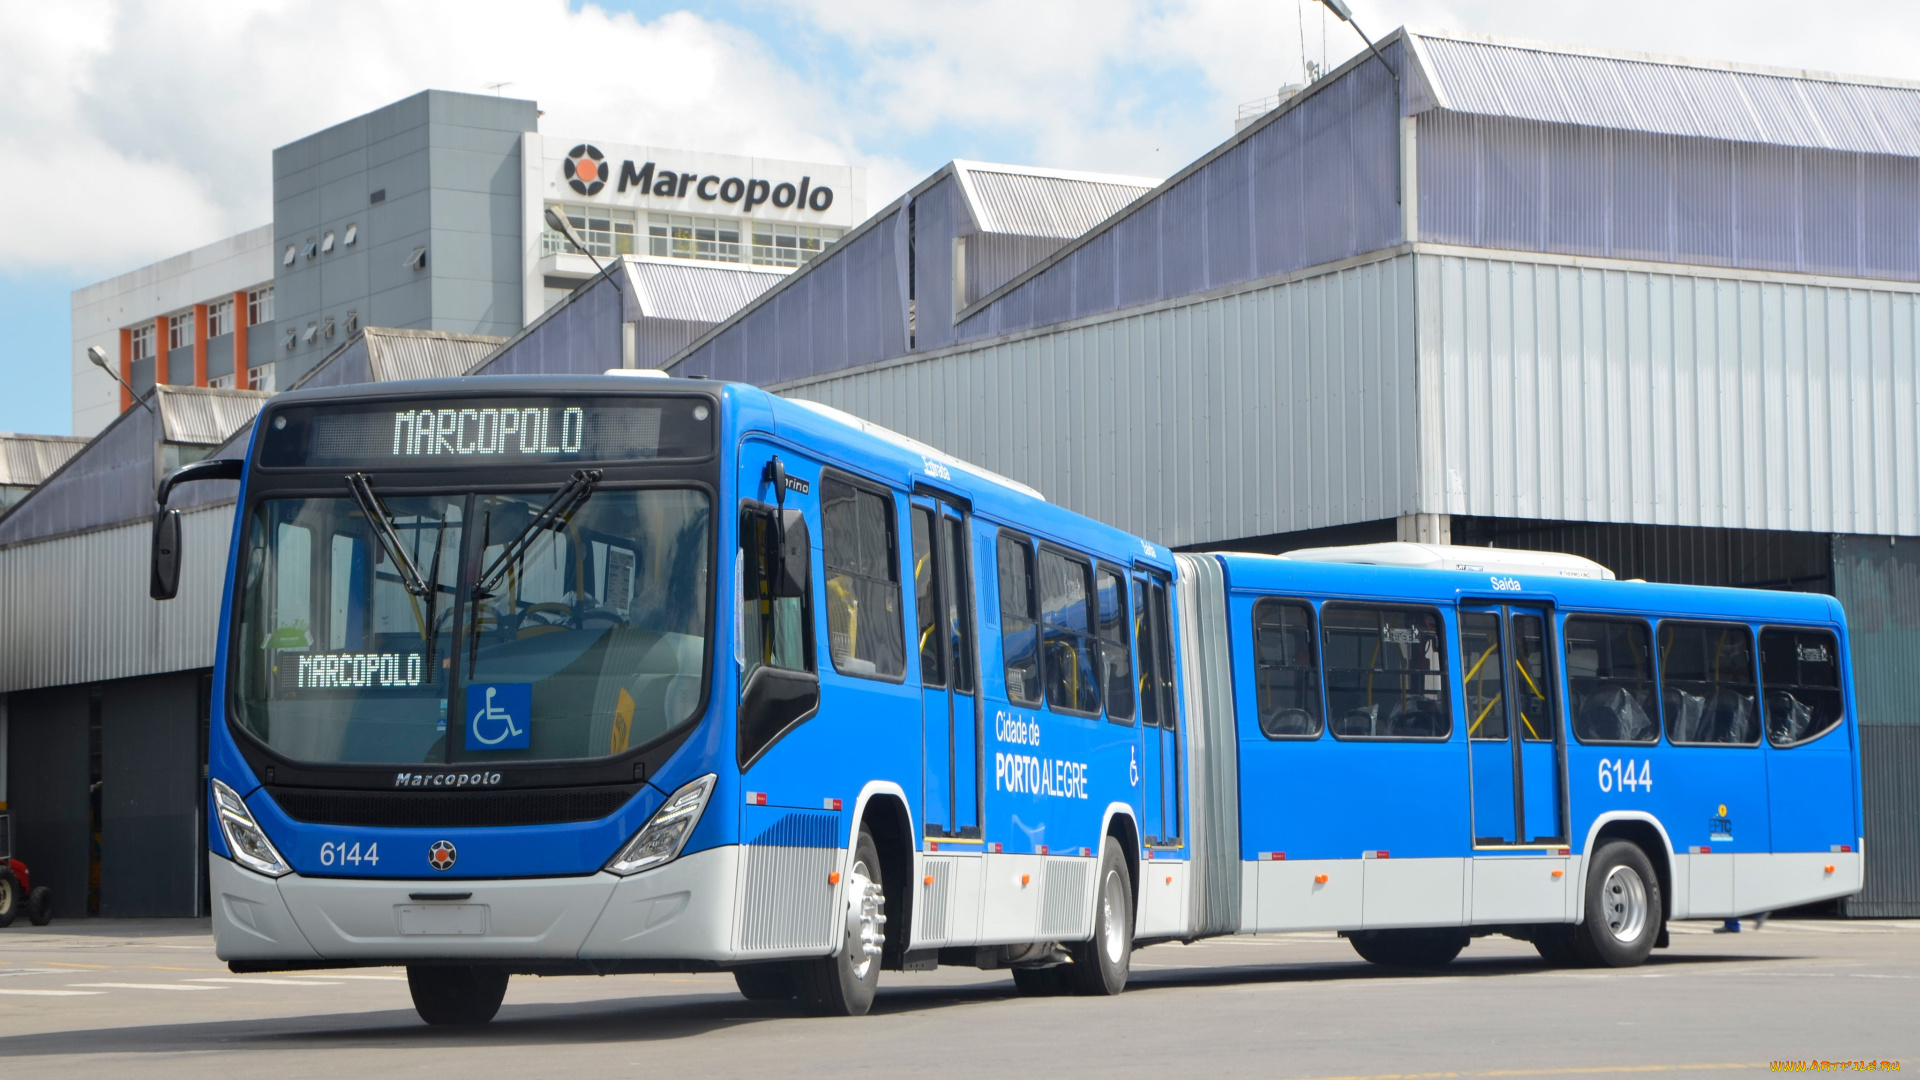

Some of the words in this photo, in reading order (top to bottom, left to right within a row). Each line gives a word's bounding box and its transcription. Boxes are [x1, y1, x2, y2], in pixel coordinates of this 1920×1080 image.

[617, 160, 834, 212] Marcopolo
[393, 407, 584, 455] MARCOPOLO
[298, 653, 421, 687] MARCOPOLO
[996, 710, 1027, 745] Cidade
[1029, 716, 1040, 747] de
[395, 771, 501, 787] Marcopolo
[996, 752, 1040, 795] PORTO
[1041, 758, 1088, 800] ALEGRE
[1598, 758, 1653, 793] 6144
[320, 841, 380, 866] 6144
